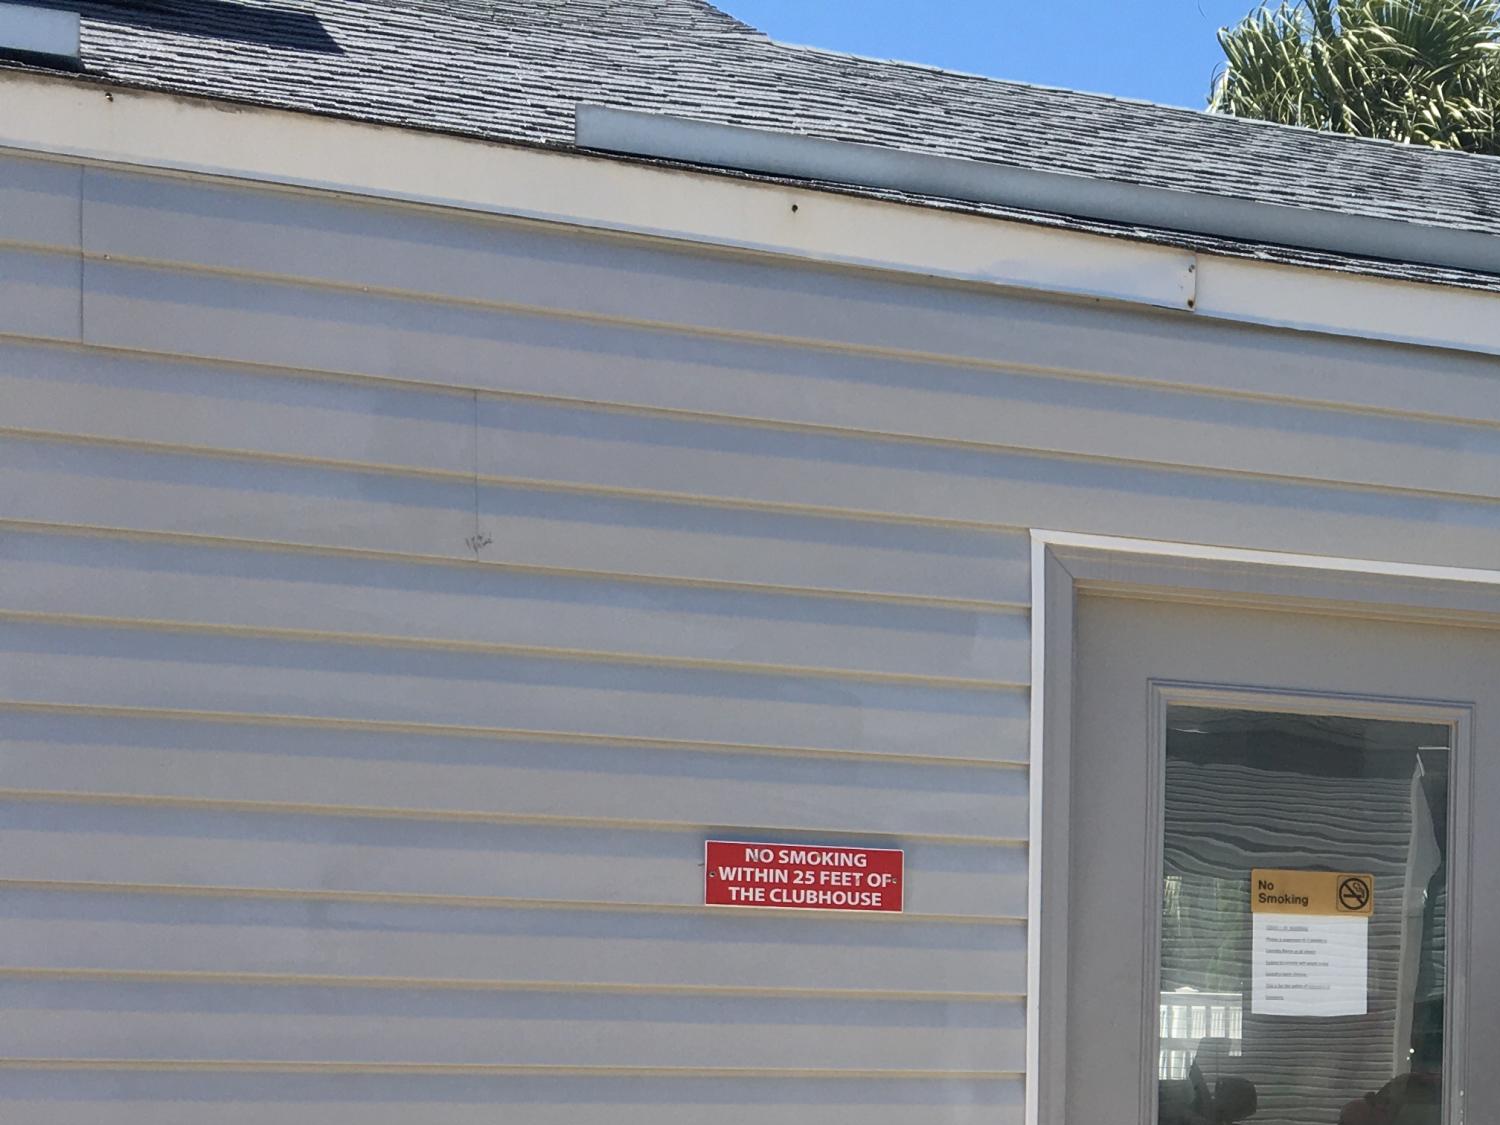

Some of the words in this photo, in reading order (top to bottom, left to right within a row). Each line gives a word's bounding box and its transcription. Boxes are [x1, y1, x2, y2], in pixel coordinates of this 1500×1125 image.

[745, 848, 774, 863] NO
[779, 851, 867, 867] SMOKING
[719, 867, 788, 882] WITHIN
[793, 871, 815, 884] 25
[821, 872, 863, 886] FEET
[866, 873, 891, 888] OF
[1258, 879, 1274, 891] No
[728, 886, 765, 902] THE
[770, 889, 882, 906] CLUBHOUSE
[1258, 892, 1309, 907] Smoking
